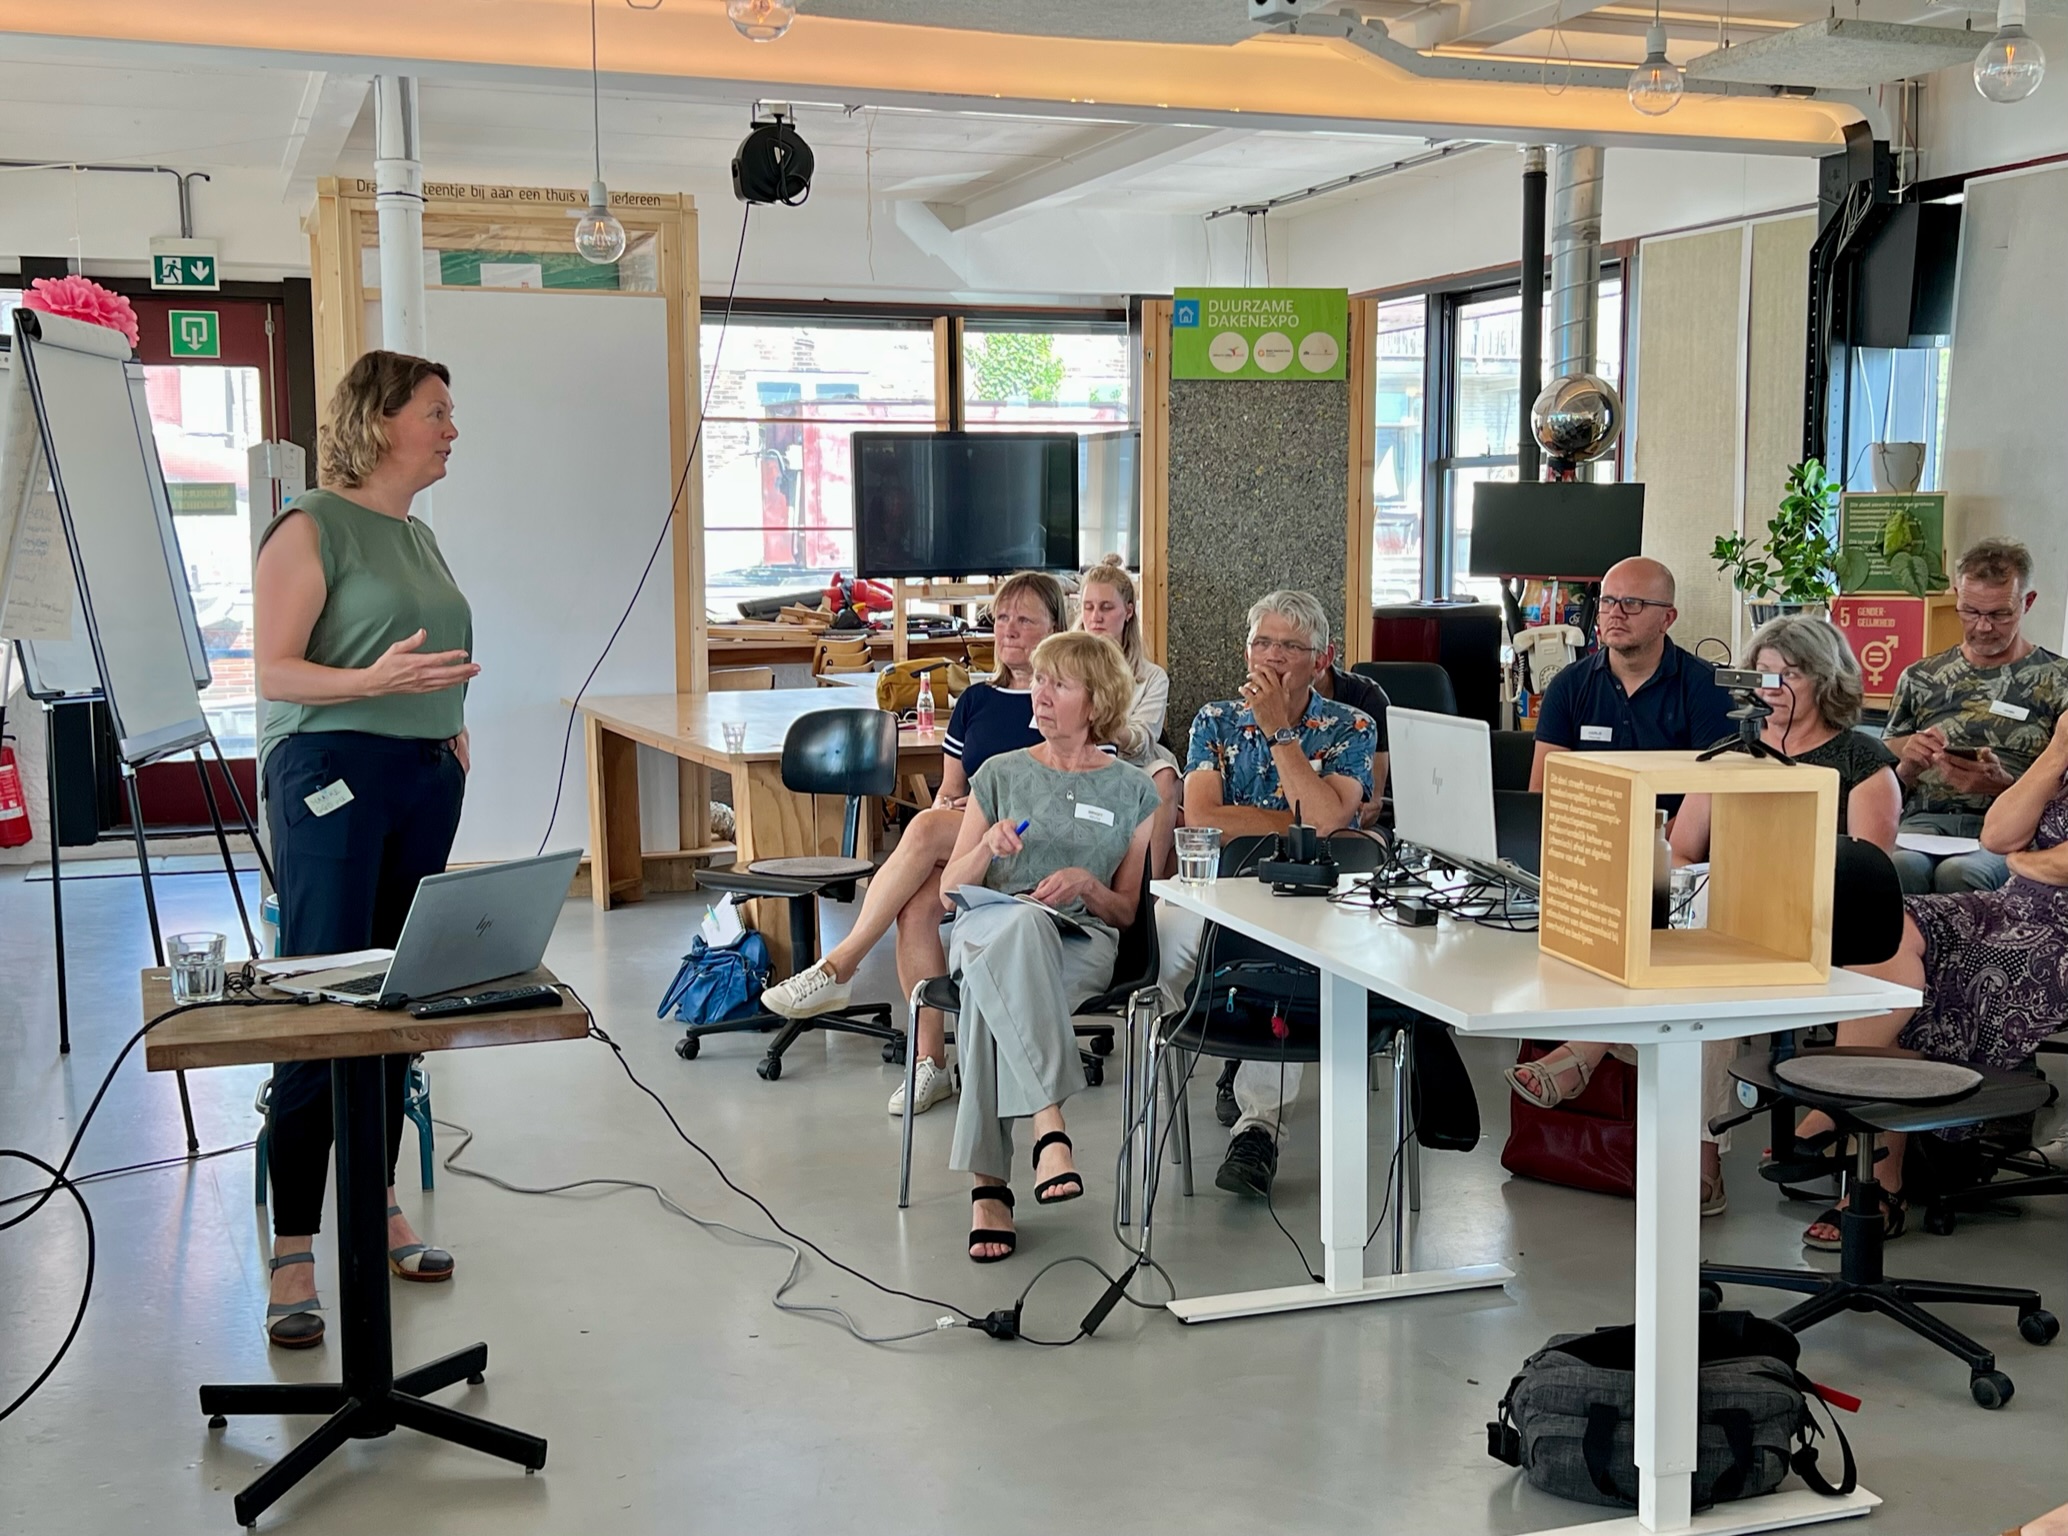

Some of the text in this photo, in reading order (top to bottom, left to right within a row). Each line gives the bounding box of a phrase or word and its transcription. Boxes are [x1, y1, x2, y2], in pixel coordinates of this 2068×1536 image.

[356, 179, 377, 193] Dra
[422, 182, 466, 199] teentje
[470, 184, 485, 200] bij
[490, 188, 514, 199] aan
[519, 189, 541, 201] een
[546, 189, 576, 202] thuis
[611, 192, 661, 206] iedereen
[1208, 299, 1294, 313] DUURZAME
[1208, 314, 1299, 328] DAKENEXPO
[1840, 607, 1850, 627] 5
